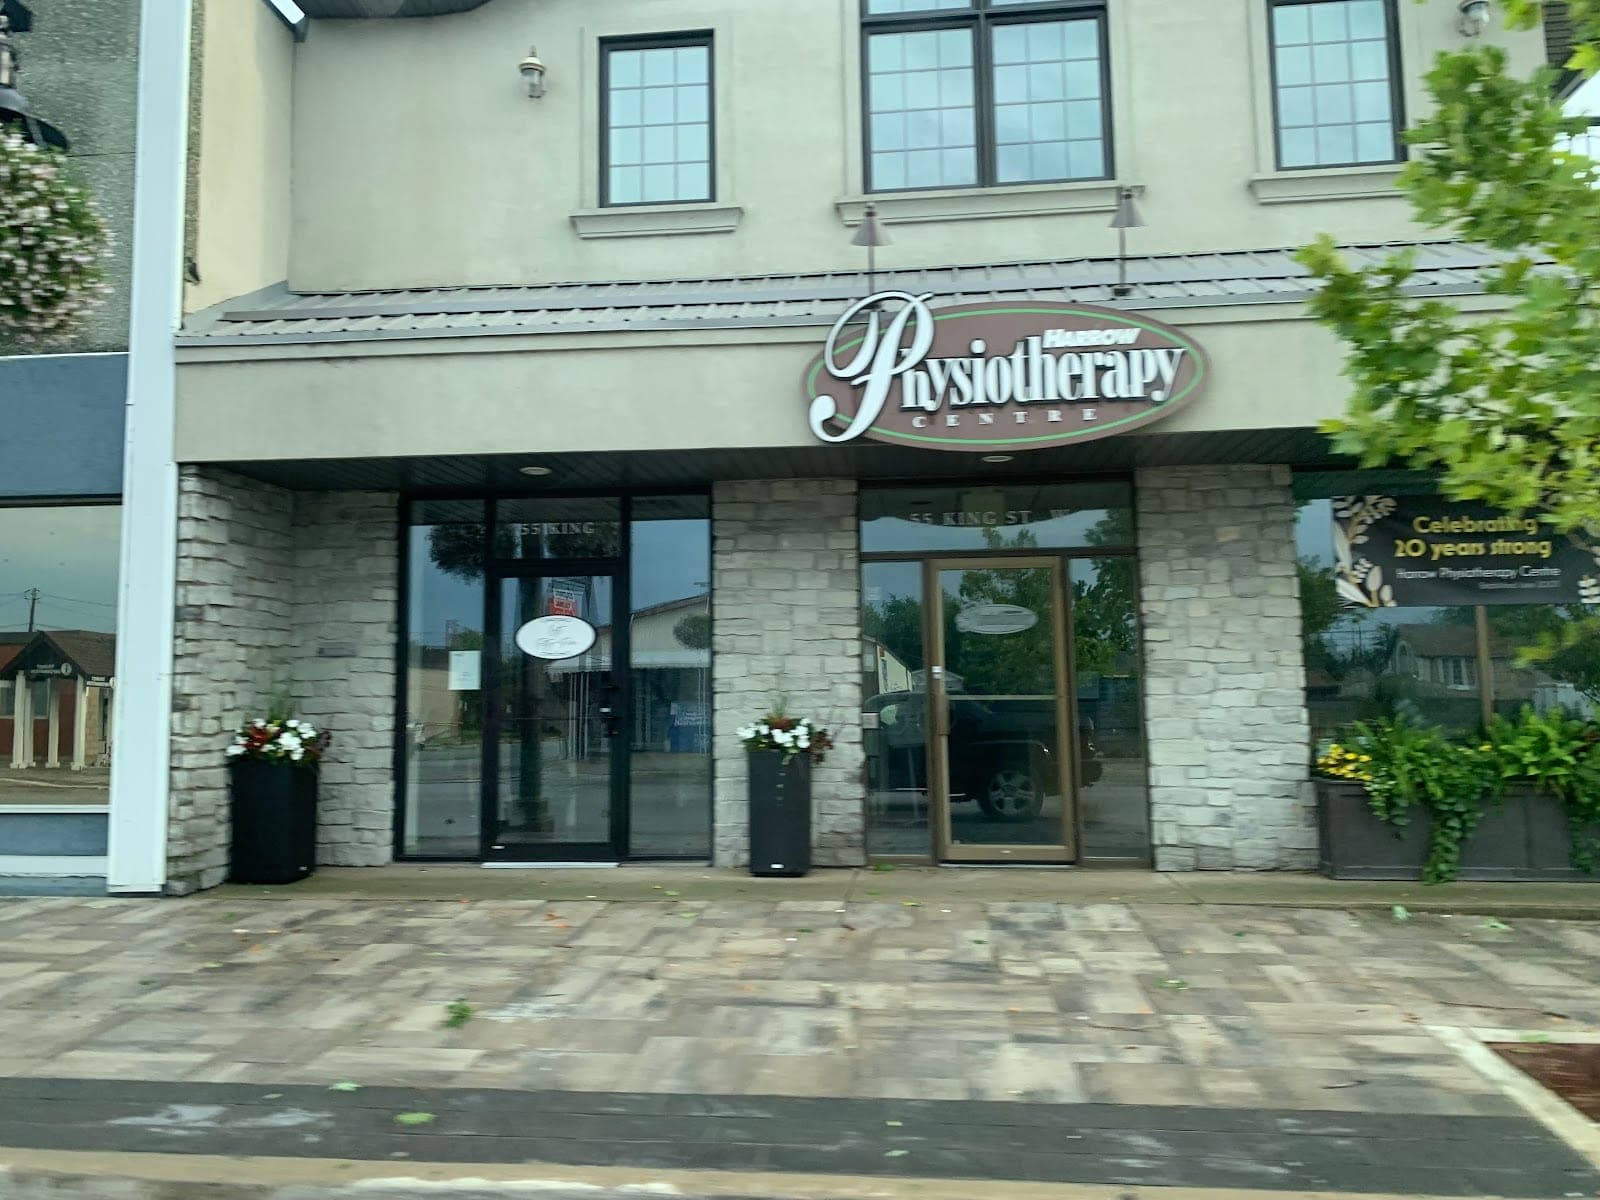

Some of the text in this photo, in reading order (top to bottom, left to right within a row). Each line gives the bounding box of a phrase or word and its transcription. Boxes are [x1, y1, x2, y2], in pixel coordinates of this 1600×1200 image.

[808, 290, 1187, 444] Physiotherapy
[911, 407, 1098, 429] CENTRE
[548, 521, 595, 534] KING
[943, 511, 997, 525] KING
[1412, 515, 1538, 535] Celebrating
[1394, 538, 1552, 560] 20 years strong
